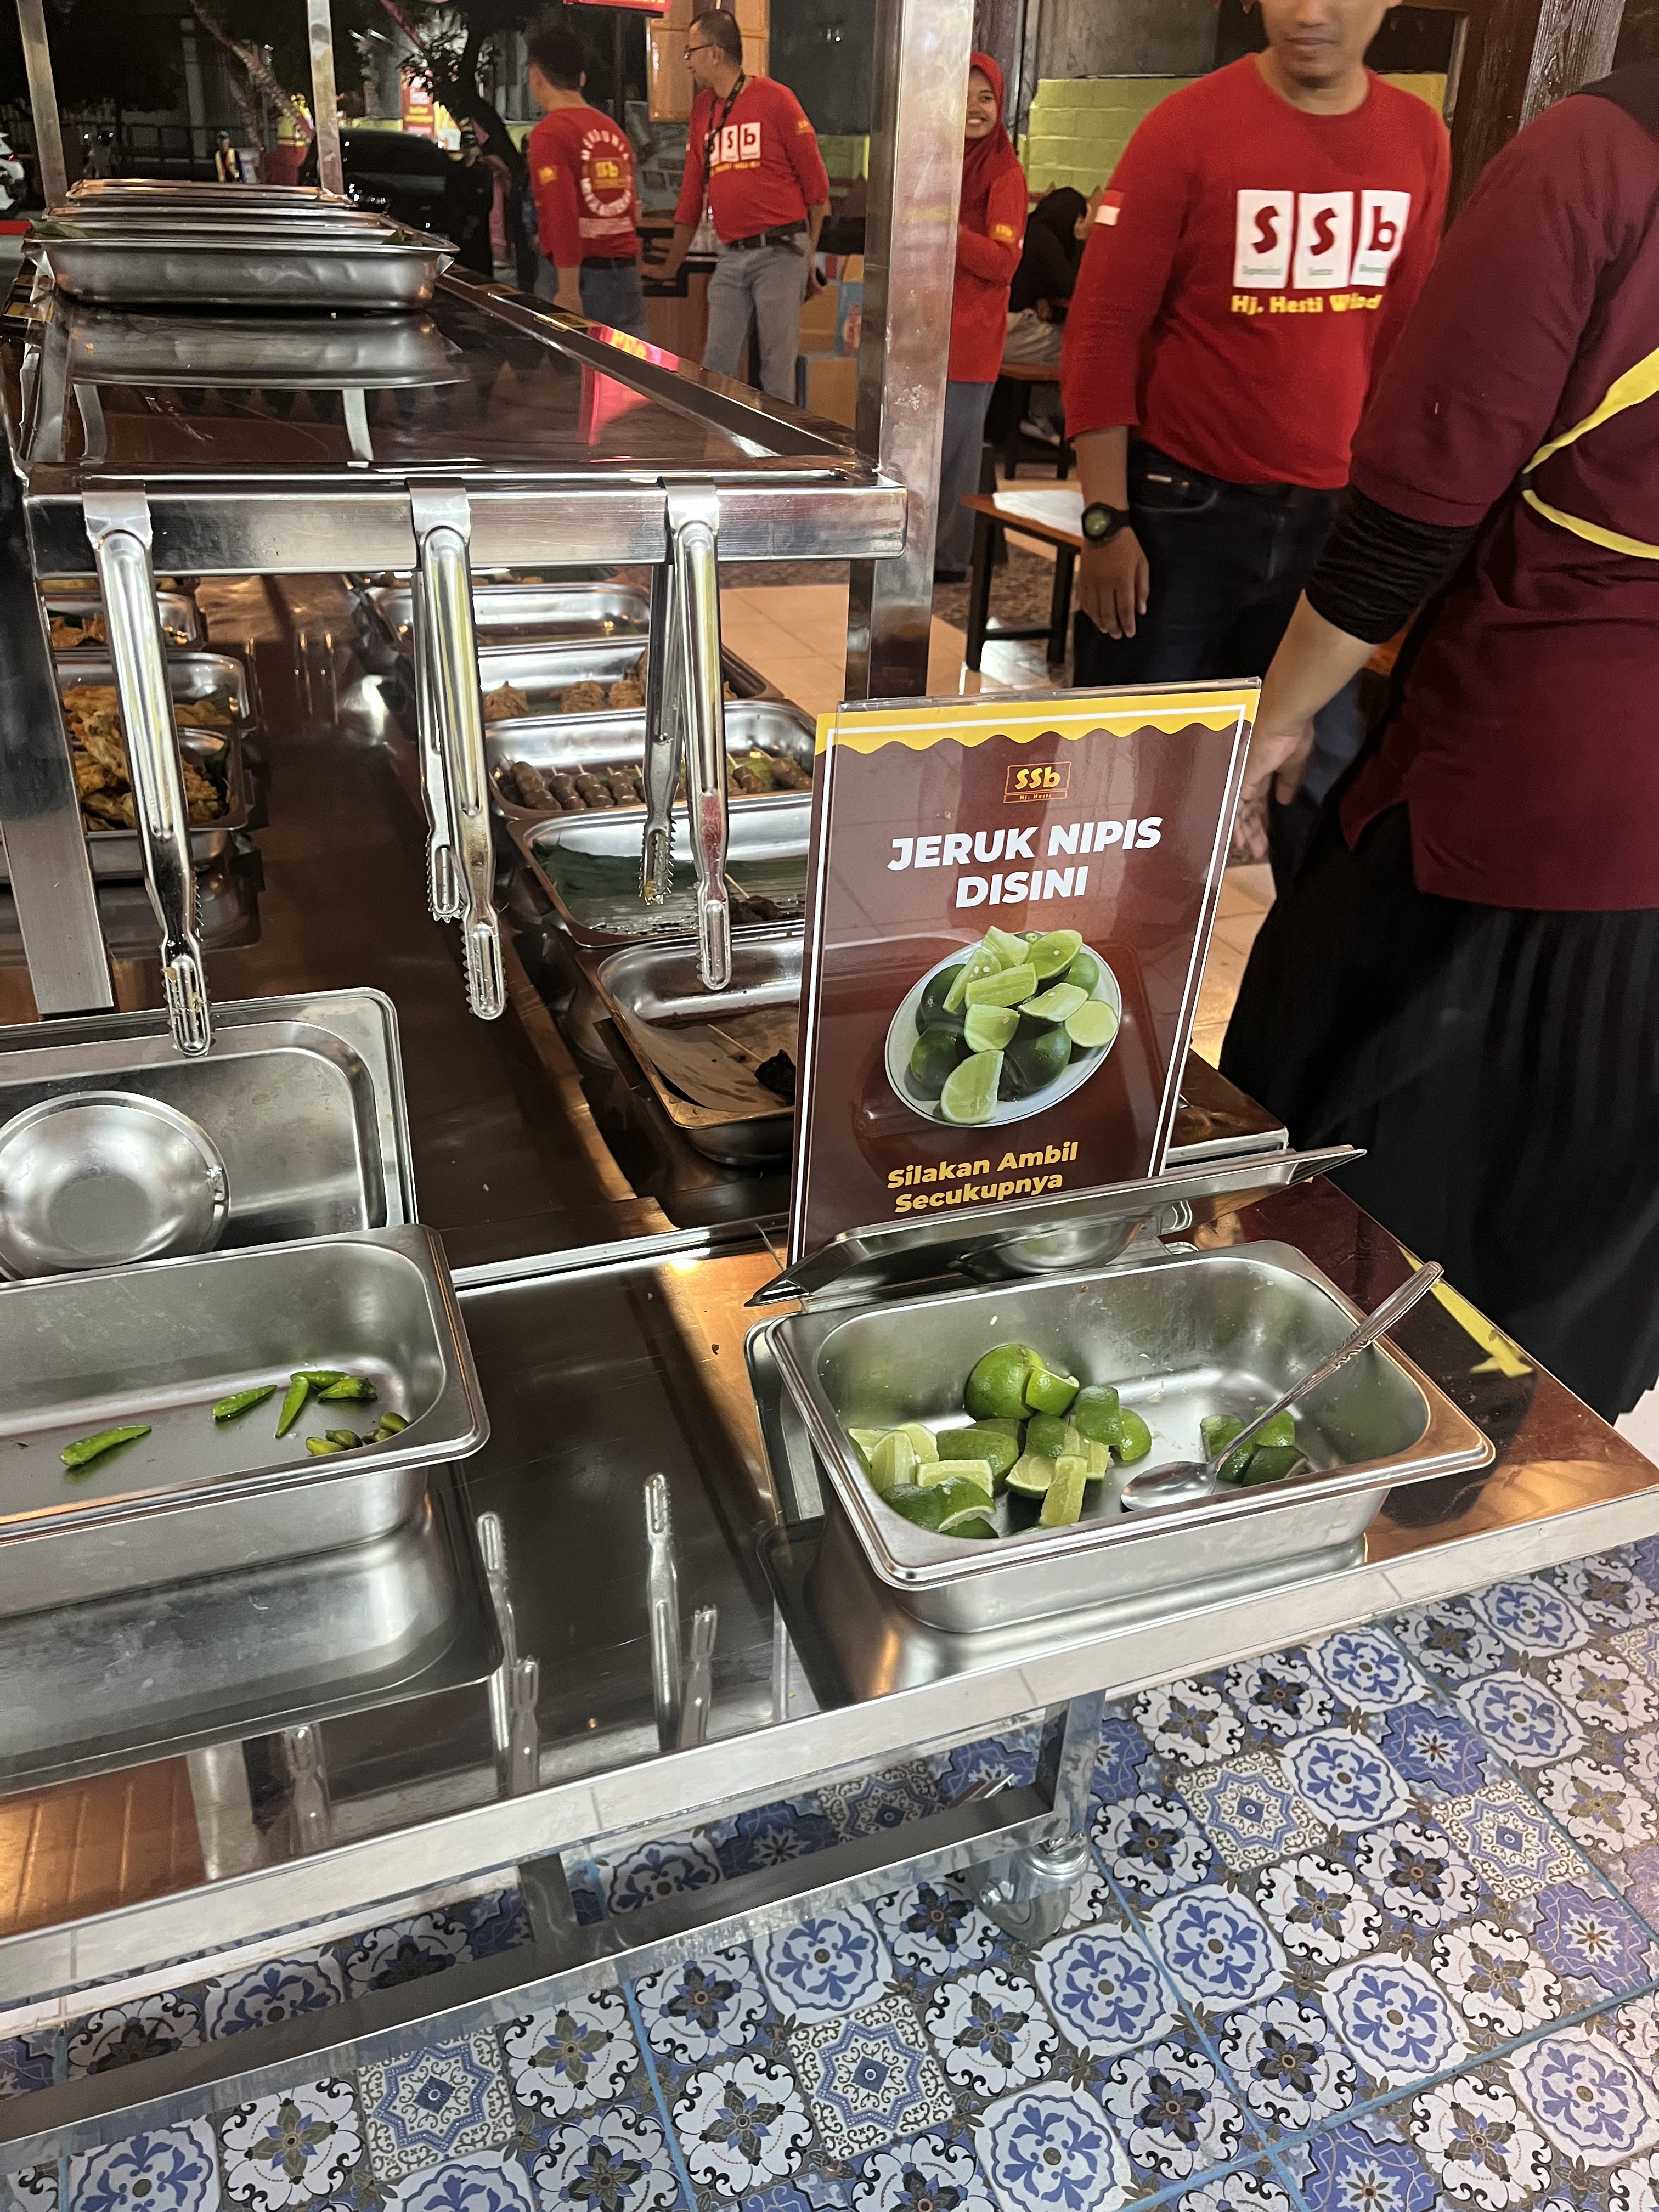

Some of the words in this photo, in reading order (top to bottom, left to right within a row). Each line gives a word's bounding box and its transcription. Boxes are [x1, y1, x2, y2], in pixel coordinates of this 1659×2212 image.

[1231, 295, 1264, 315] Hj.
[1269, 296, 1323, 313] Hesti
[1015, 766, 1060, 789] SSb
[887, 826, 1039, 871] JERUK
[1047, 817, 1163, 856] NIPIS
[956, 866, 1089, 909] DISINI
[887, 1159, 990, 1189] Silakan
[996, 1141, 1079, 1172] Ambil
[895, 1173, 1063, 1213] Secukupnya
